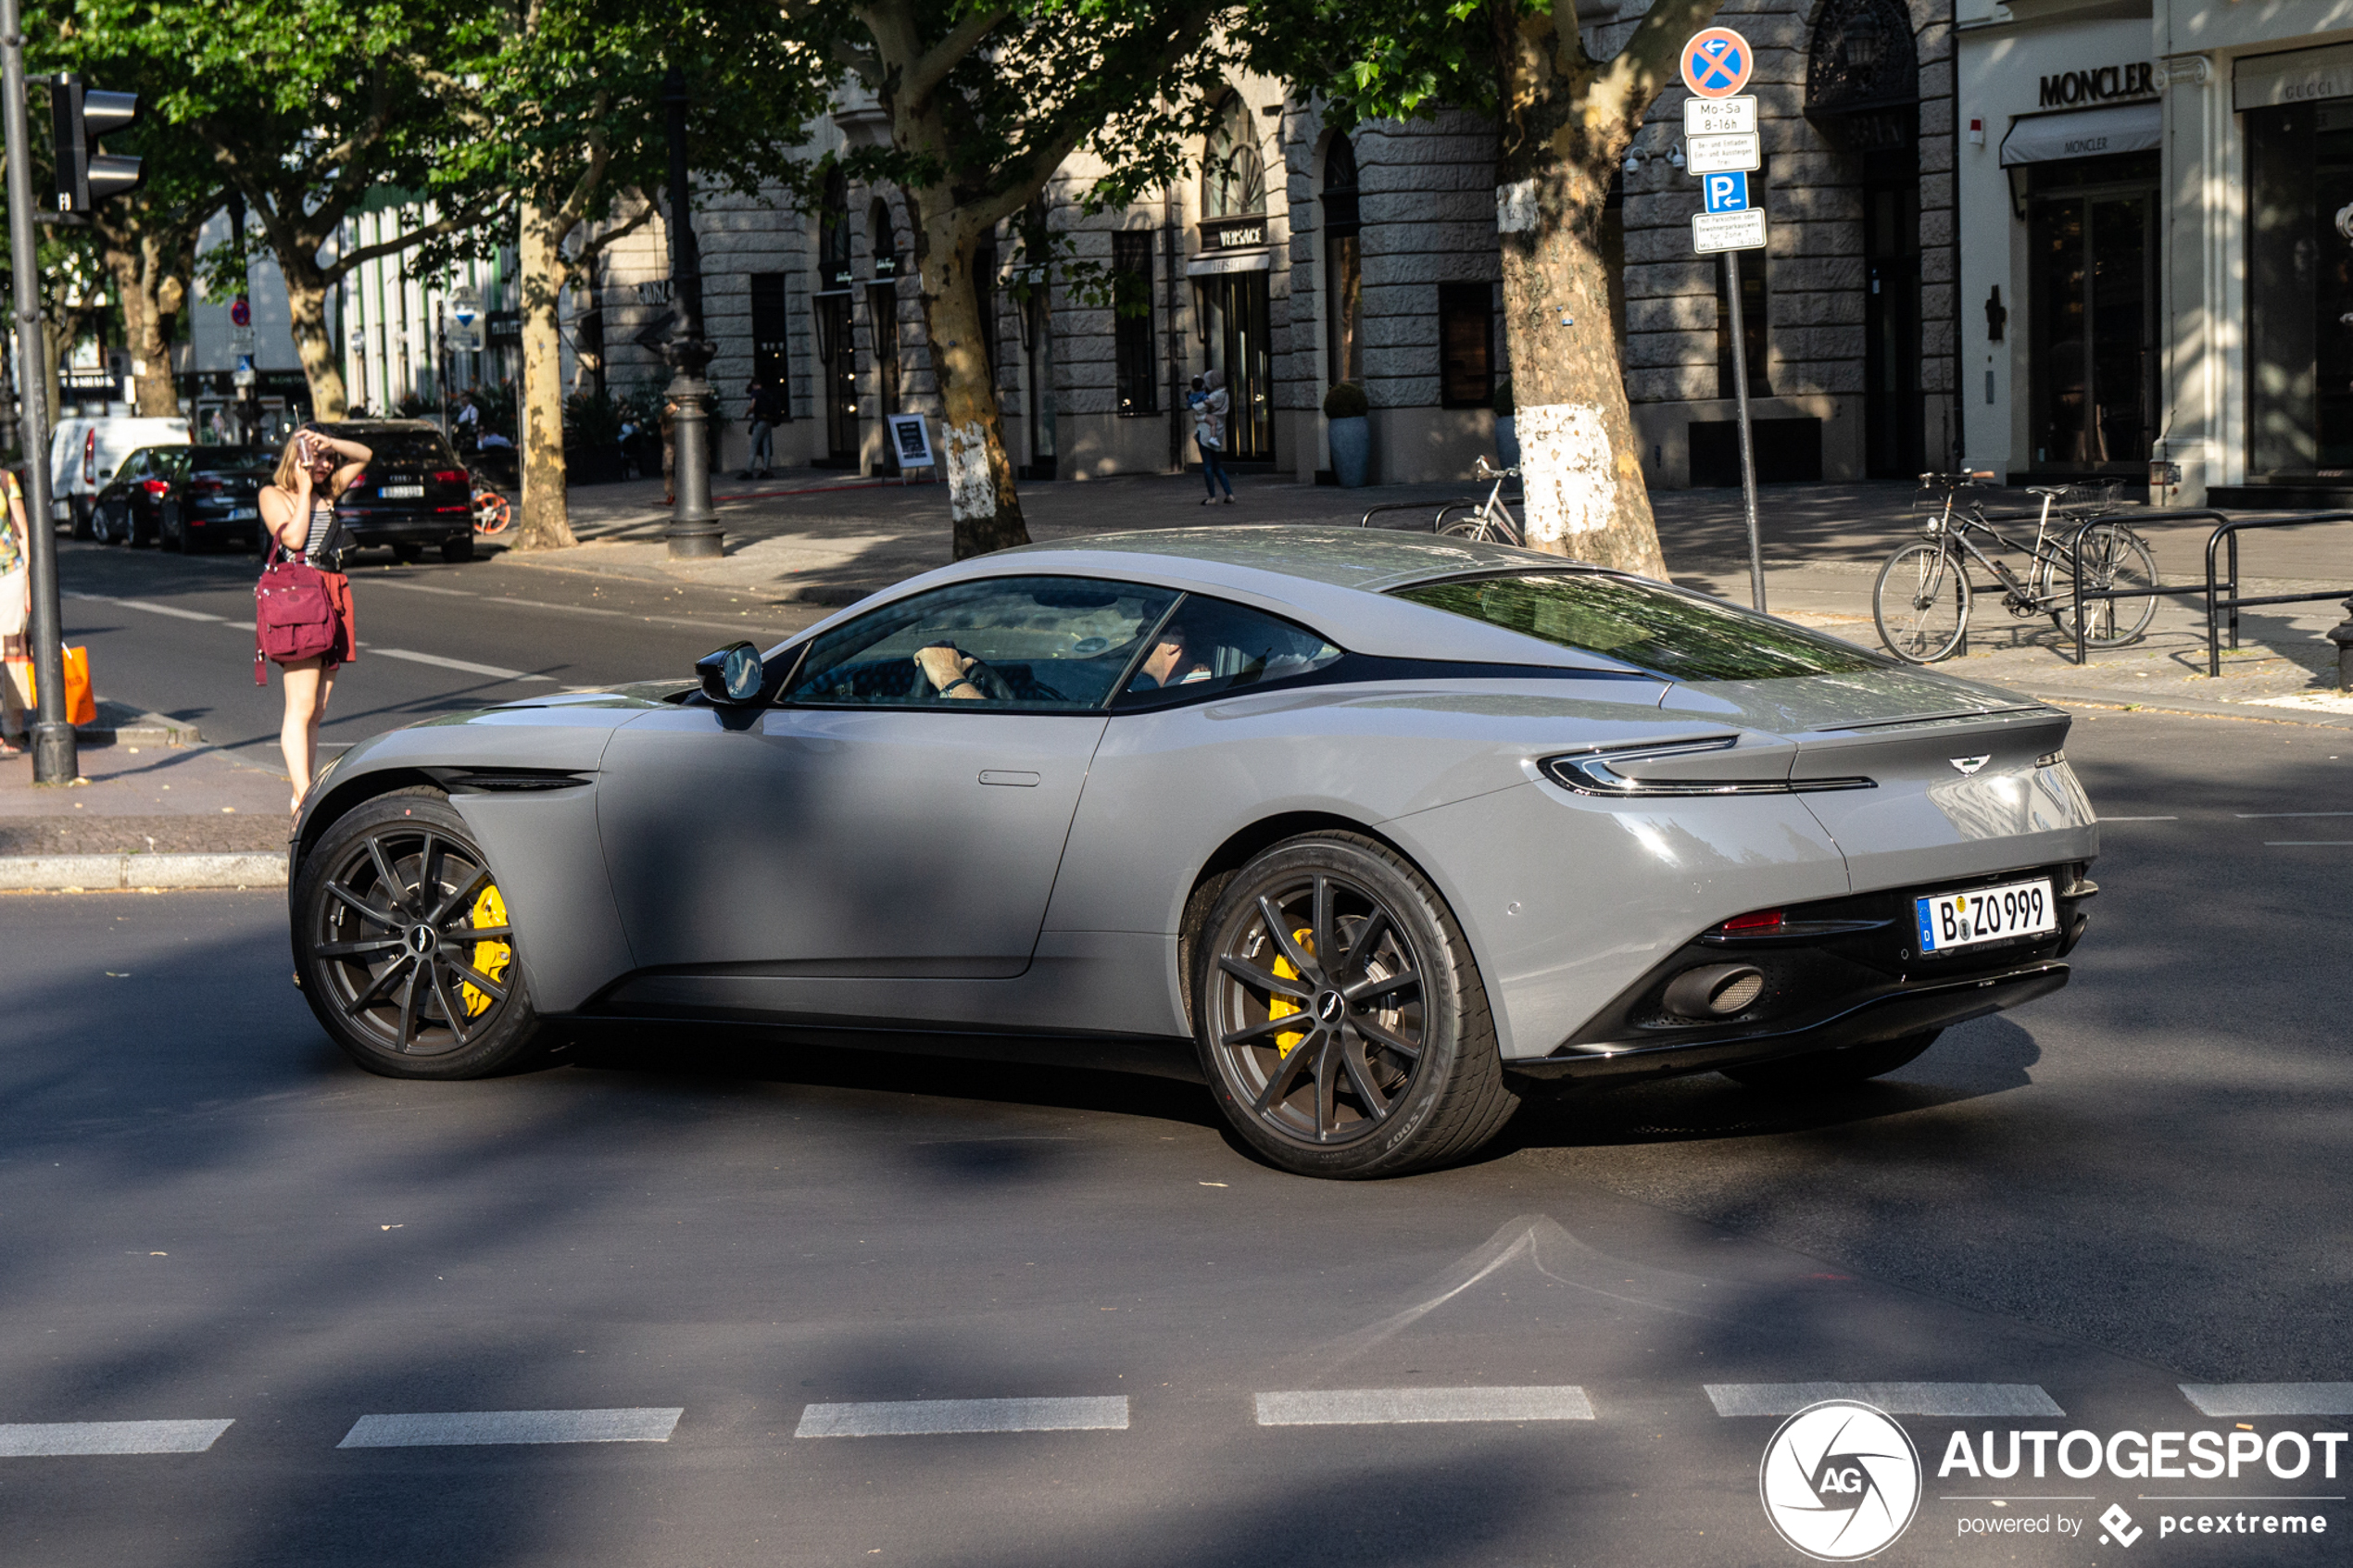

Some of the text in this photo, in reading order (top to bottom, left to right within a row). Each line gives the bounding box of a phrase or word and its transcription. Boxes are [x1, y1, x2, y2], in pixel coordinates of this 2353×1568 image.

[2040, 61, 2157, 107] MONCLER
[2285, 82, 2332, 99] GUCCI
[1701, 103, 1741, 115] Mo-Sa
[1705, 119, 1737, 130] 8-16h
[2064, 137, 2108, 155] MONCLER
[58, 192, 71, 211] F9
[1710, 176, 1734, 208] P
[1220, 227, 1262, 247] VERSACE
[1941, 901, 1957, 941] B
[2004, 887, 2044, 931] 999
[1924, 930, 1931, 942] D
[1386, 1112, 1419, 1150] S007
